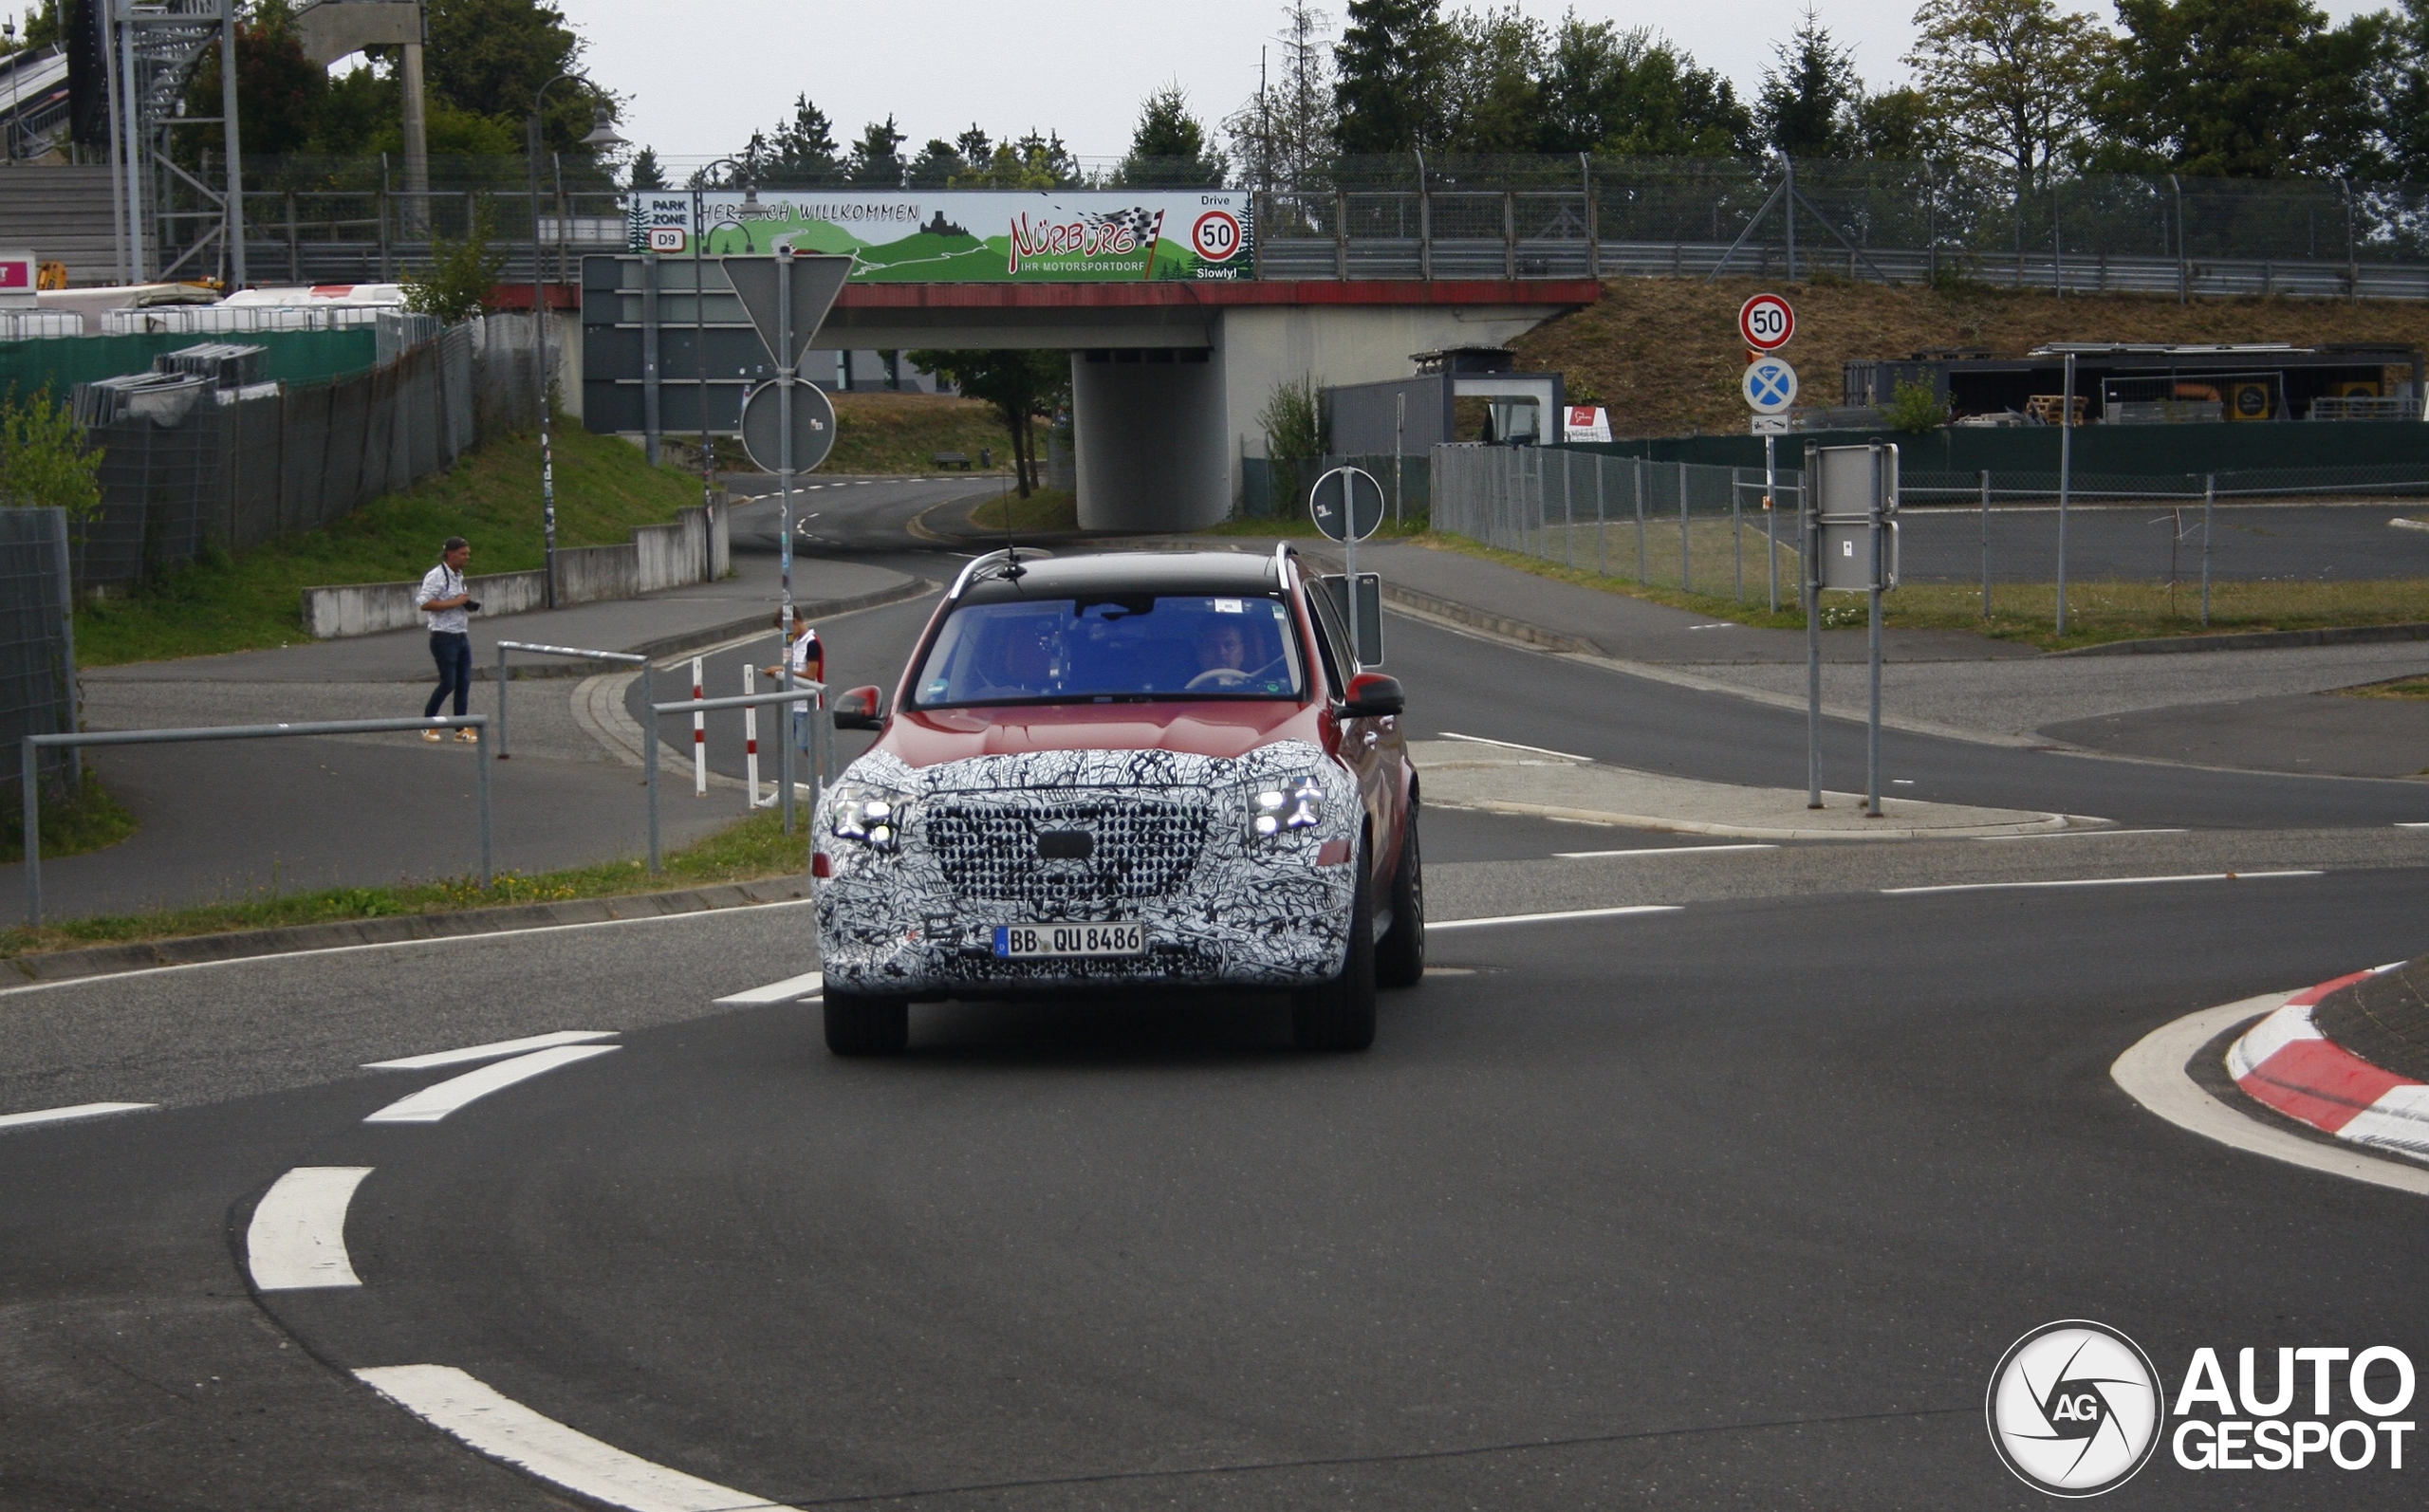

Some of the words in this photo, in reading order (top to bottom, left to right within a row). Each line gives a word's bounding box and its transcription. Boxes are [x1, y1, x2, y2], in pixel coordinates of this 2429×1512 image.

[653, 200, 687, 211] PARK
[1201, 195, 1230, 205] Drive
[799, 203, 919, 222] WILLKOMMEN
[653, 214, 687, 225] ZONE
[658, 234, 676, 246] D9
[1203, 224, 1231, 247] 50
[1021, 262, 1039, 271] IHR
[1044, 262, 1145, 271] MOTORSPORTDORF
[1196, 267, 1237, 280] Slowly!
[1753, 309, 1783, 334] 50
[1011, 930, 1037, 952] BB
[1054, 928, 1082, 951] QU
[1086, 927, 1140, 950] 8486
